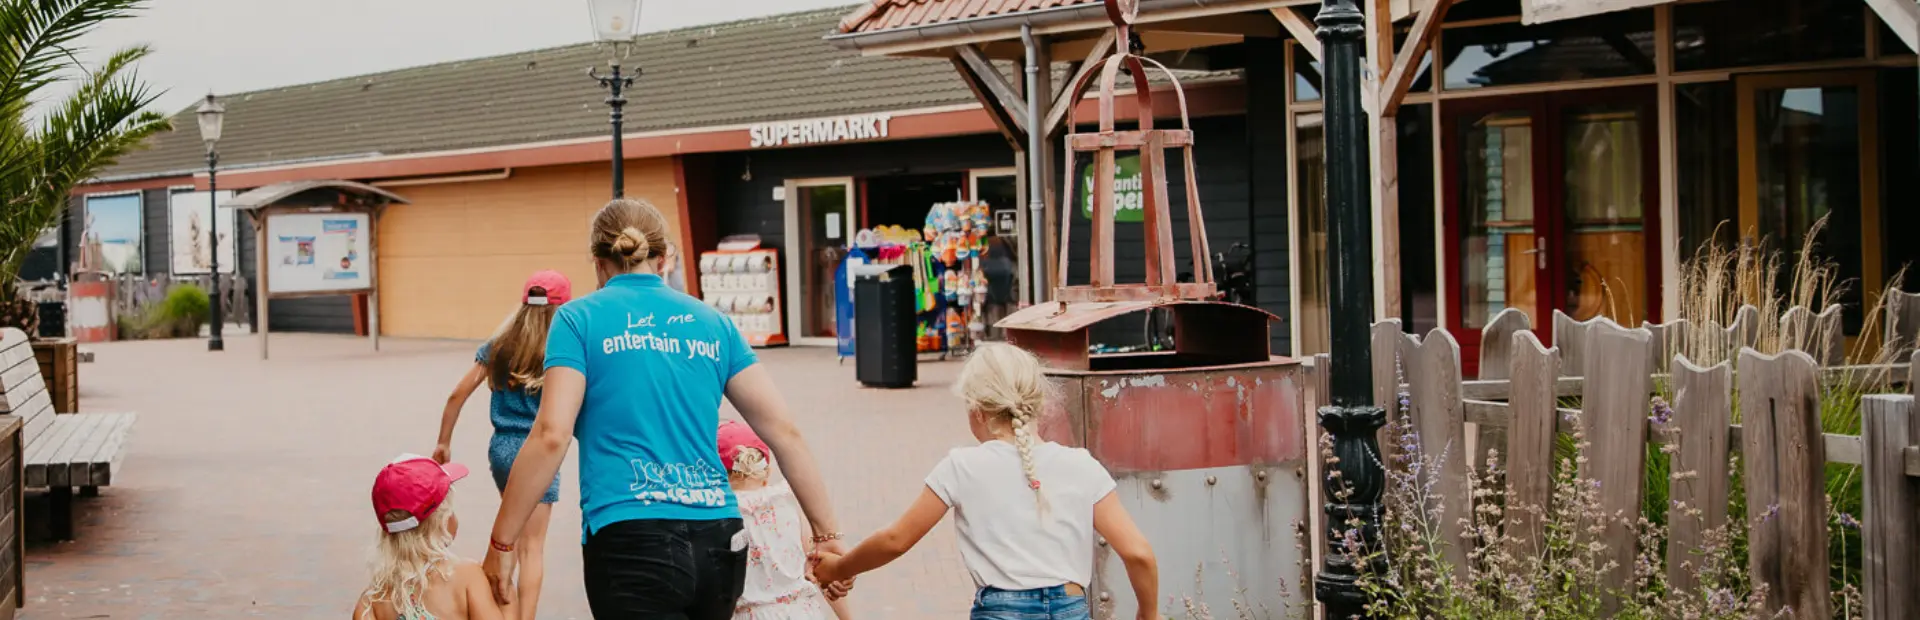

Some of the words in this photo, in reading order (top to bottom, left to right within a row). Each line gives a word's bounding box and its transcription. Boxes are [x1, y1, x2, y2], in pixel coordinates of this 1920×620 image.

[750, 113, 891, 148] SUPERMARKT
[1086, 191, 1144, 217] sper
[627, 311, 656, 328] Let
[667, 313, 696, 325] me
[602, 329, 681, 355] entertain
[685, 338, 720, 362] you!
